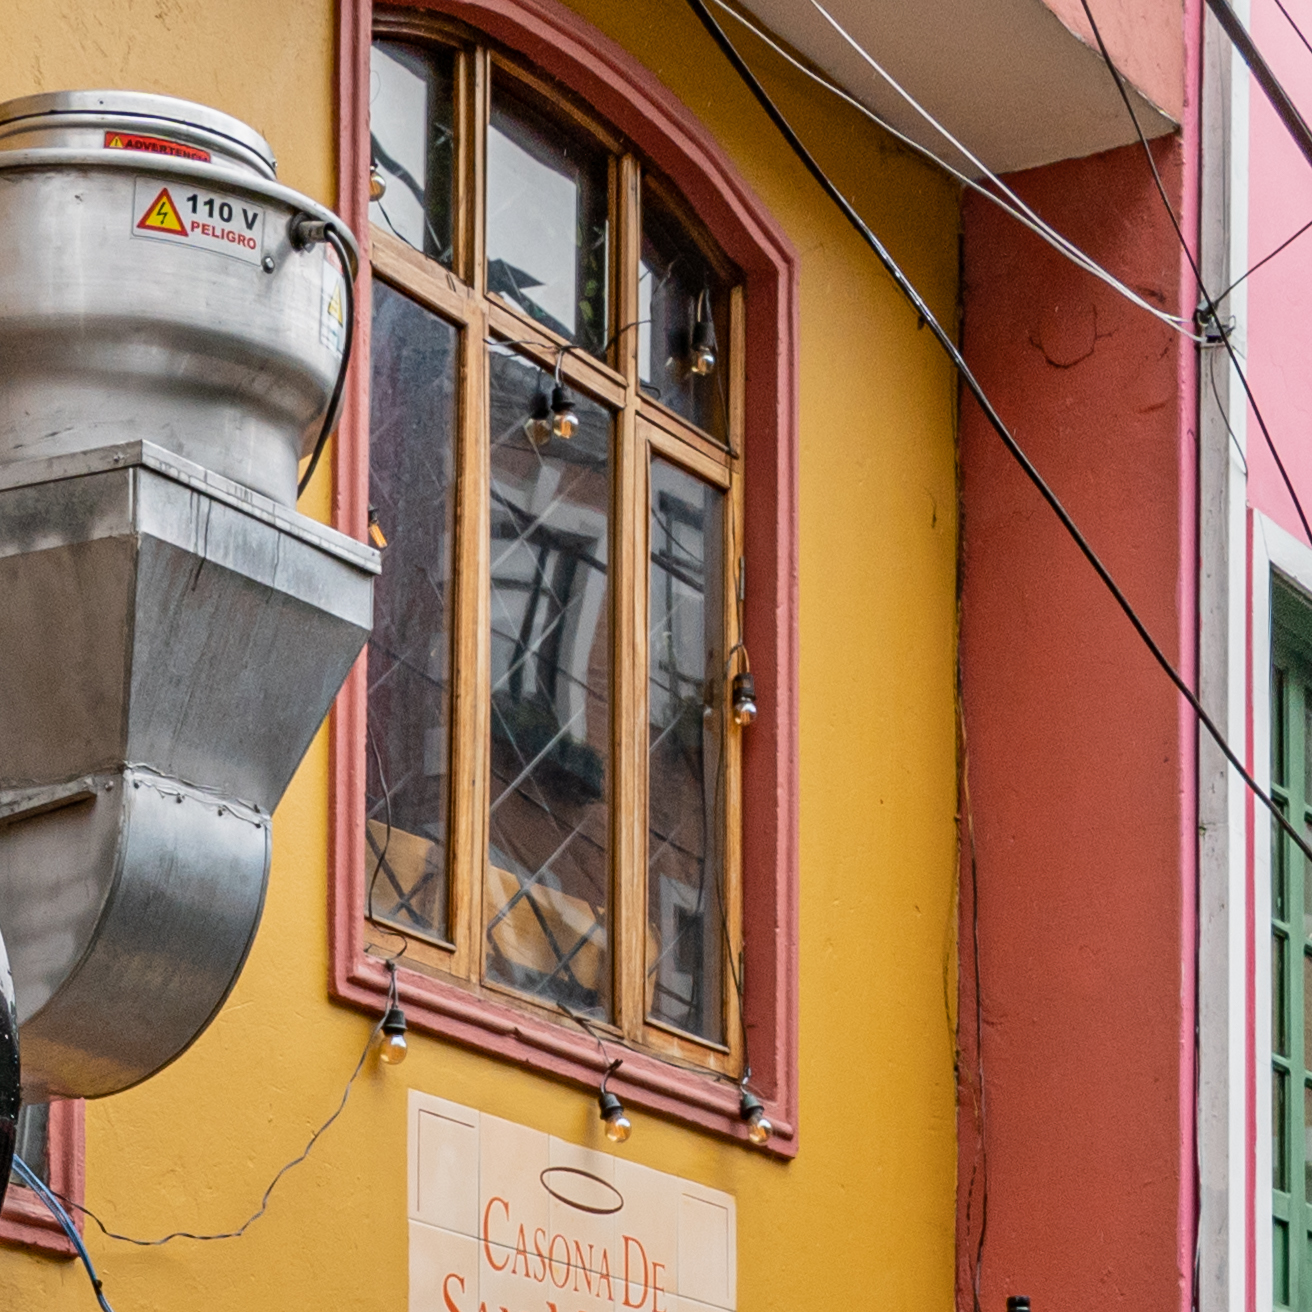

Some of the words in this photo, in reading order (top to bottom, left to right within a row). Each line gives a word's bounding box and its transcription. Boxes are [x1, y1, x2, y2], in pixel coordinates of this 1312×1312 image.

[186, 194, 233, 223] 110
[242, 208, 259, 231] V
[190, 221, 257, 250] PELIGRO
[483, 1196, 614, 1302] CASONA
